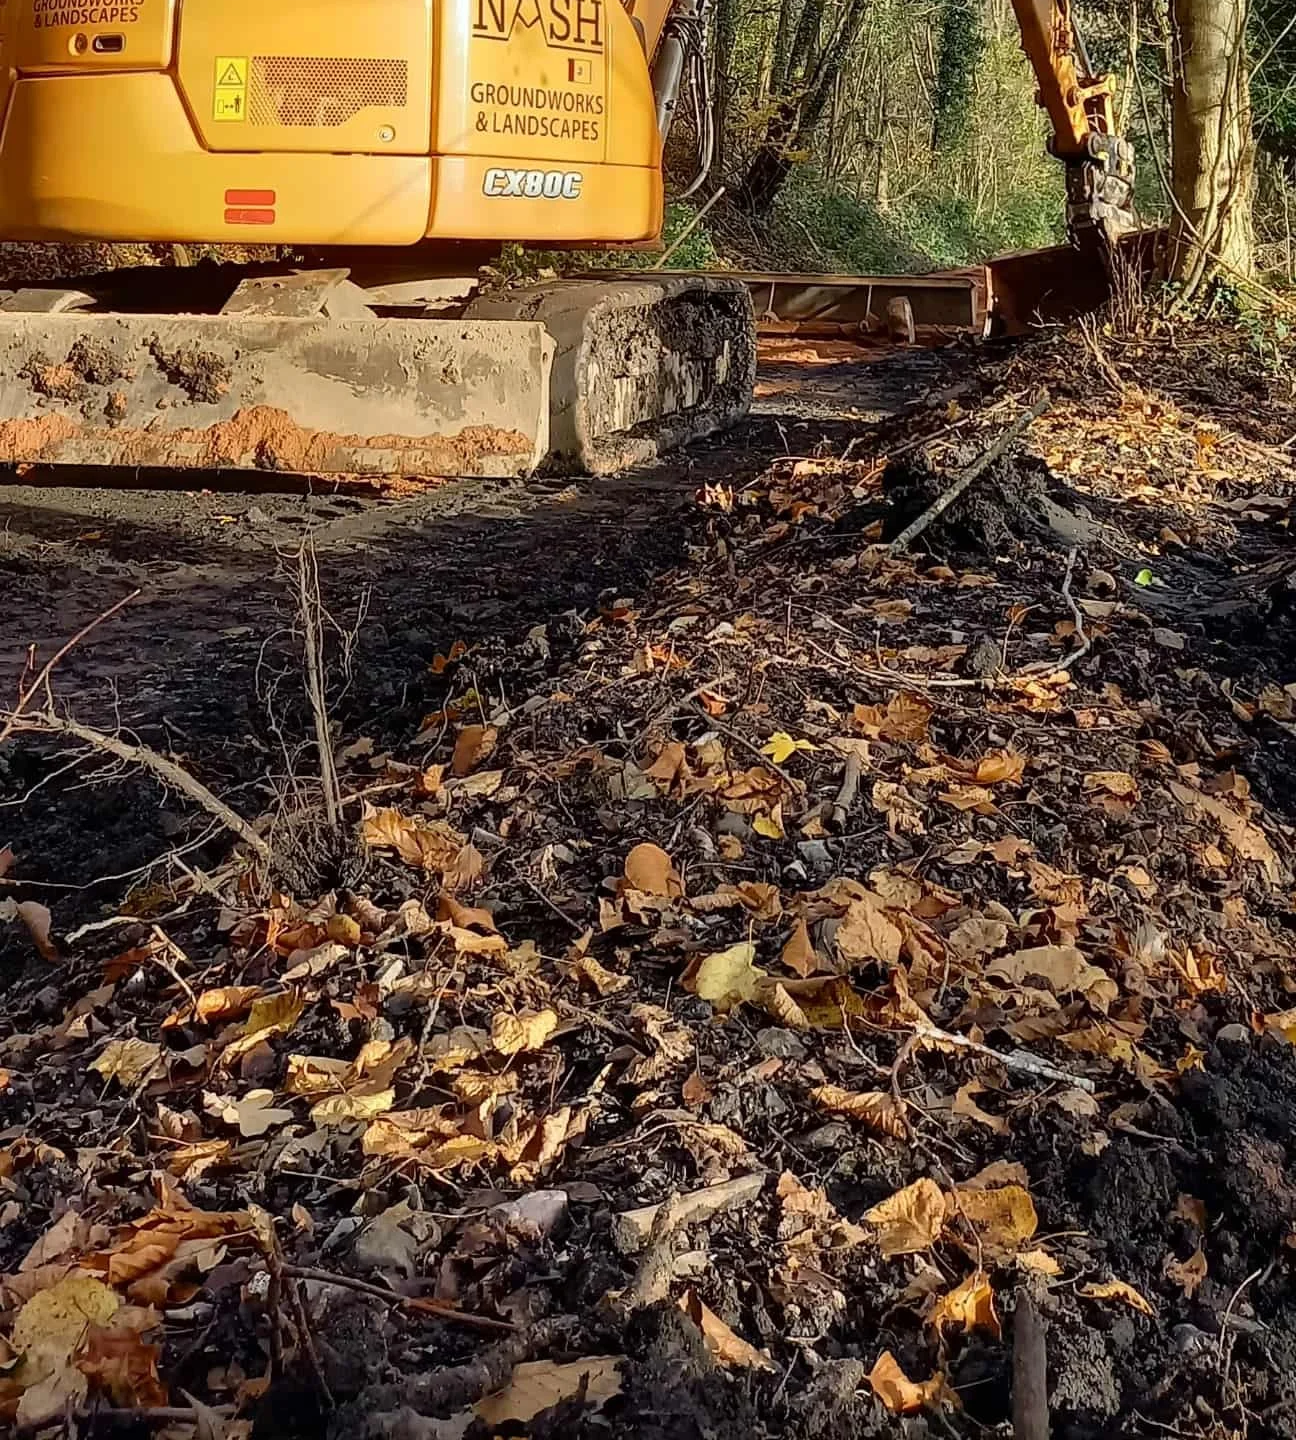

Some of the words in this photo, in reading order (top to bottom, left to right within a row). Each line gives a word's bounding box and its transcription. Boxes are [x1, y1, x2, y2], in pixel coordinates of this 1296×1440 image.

[34, 13, 43, 29] &
[44, 6, 138, 28] LANDSCAPES
[470, 82, 604, 116] GROUNDWORKS
[475, 110, 489, 133] &
[493, 112, 599, 141] LANDSCAPES
[483, 167, 584, 199] CX80C
